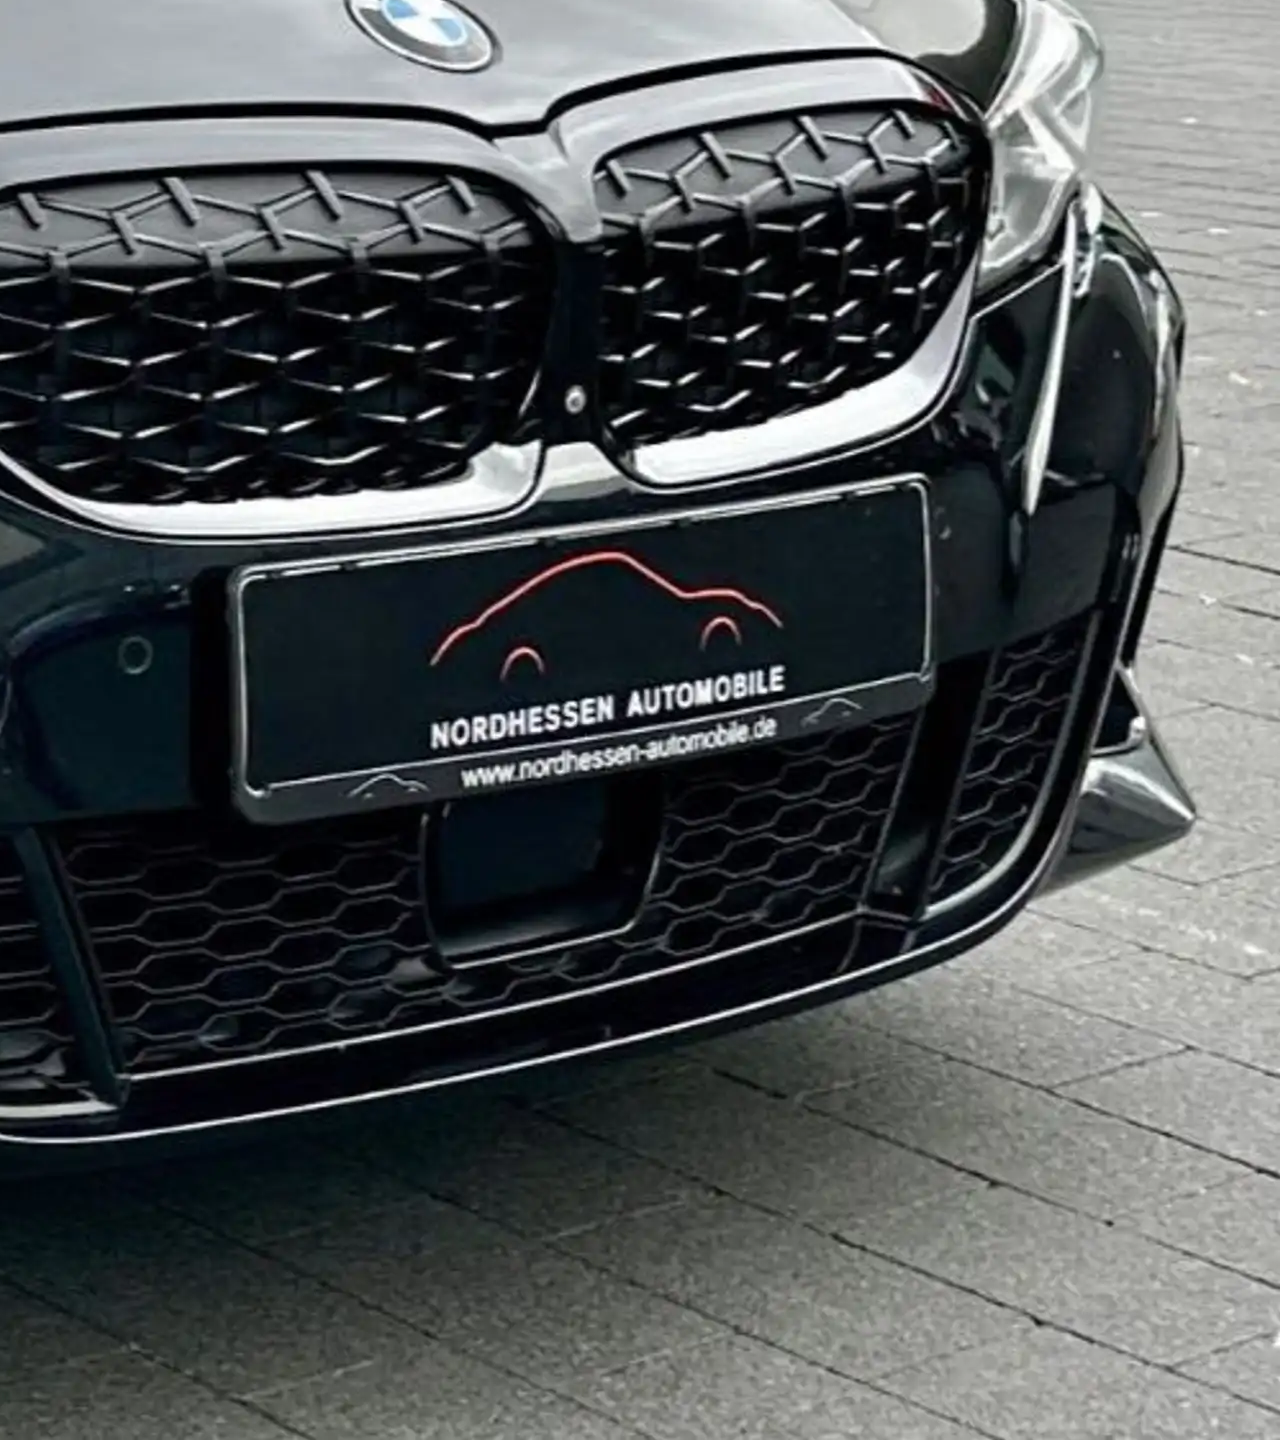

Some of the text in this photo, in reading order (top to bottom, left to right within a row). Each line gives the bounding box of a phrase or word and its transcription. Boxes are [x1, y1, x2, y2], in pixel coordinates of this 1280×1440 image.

[430, 664, 786, 750] NORDHESSEN AUTOMOBILE
[460, 715, 778, 789] www.nordhessen-automobile.de
